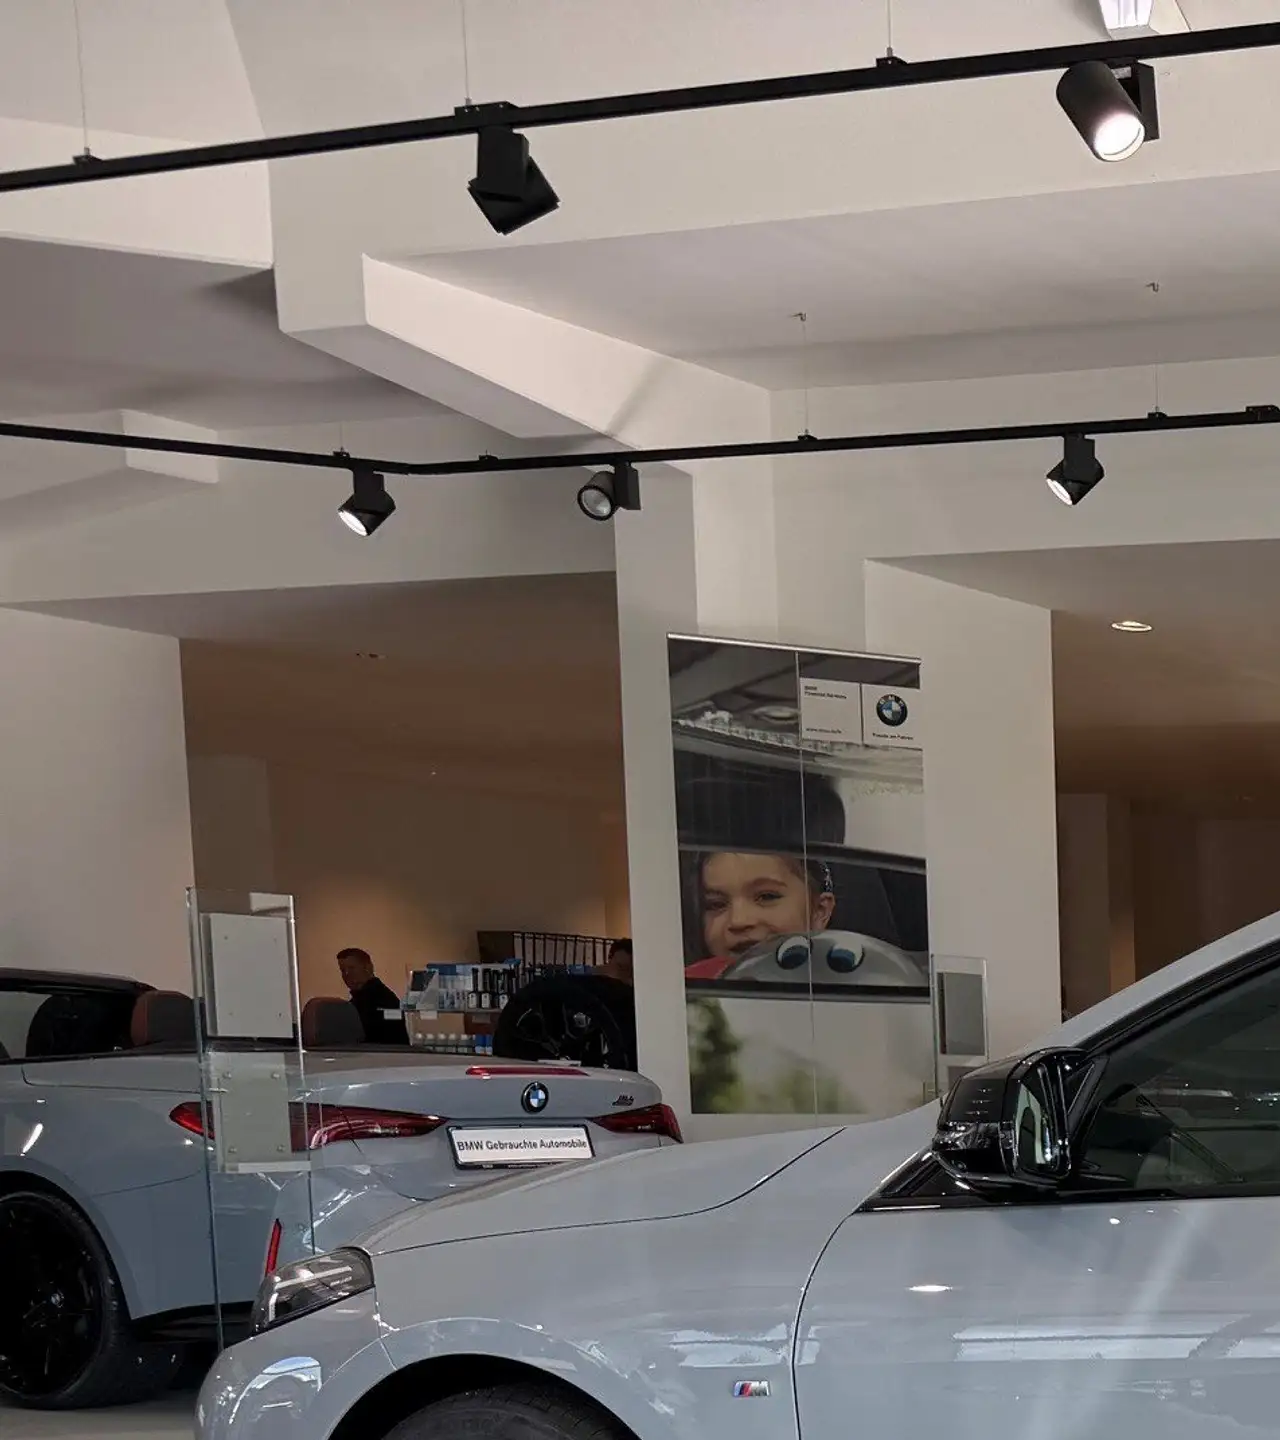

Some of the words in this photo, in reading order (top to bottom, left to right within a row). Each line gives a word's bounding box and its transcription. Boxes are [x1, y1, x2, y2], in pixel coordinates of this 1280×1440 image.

[457, 1140, 483, 1151] BMW
[485, 1139, 538, 1150] Gebrauchte
[539, 1138, 587, 1149] Automobile
